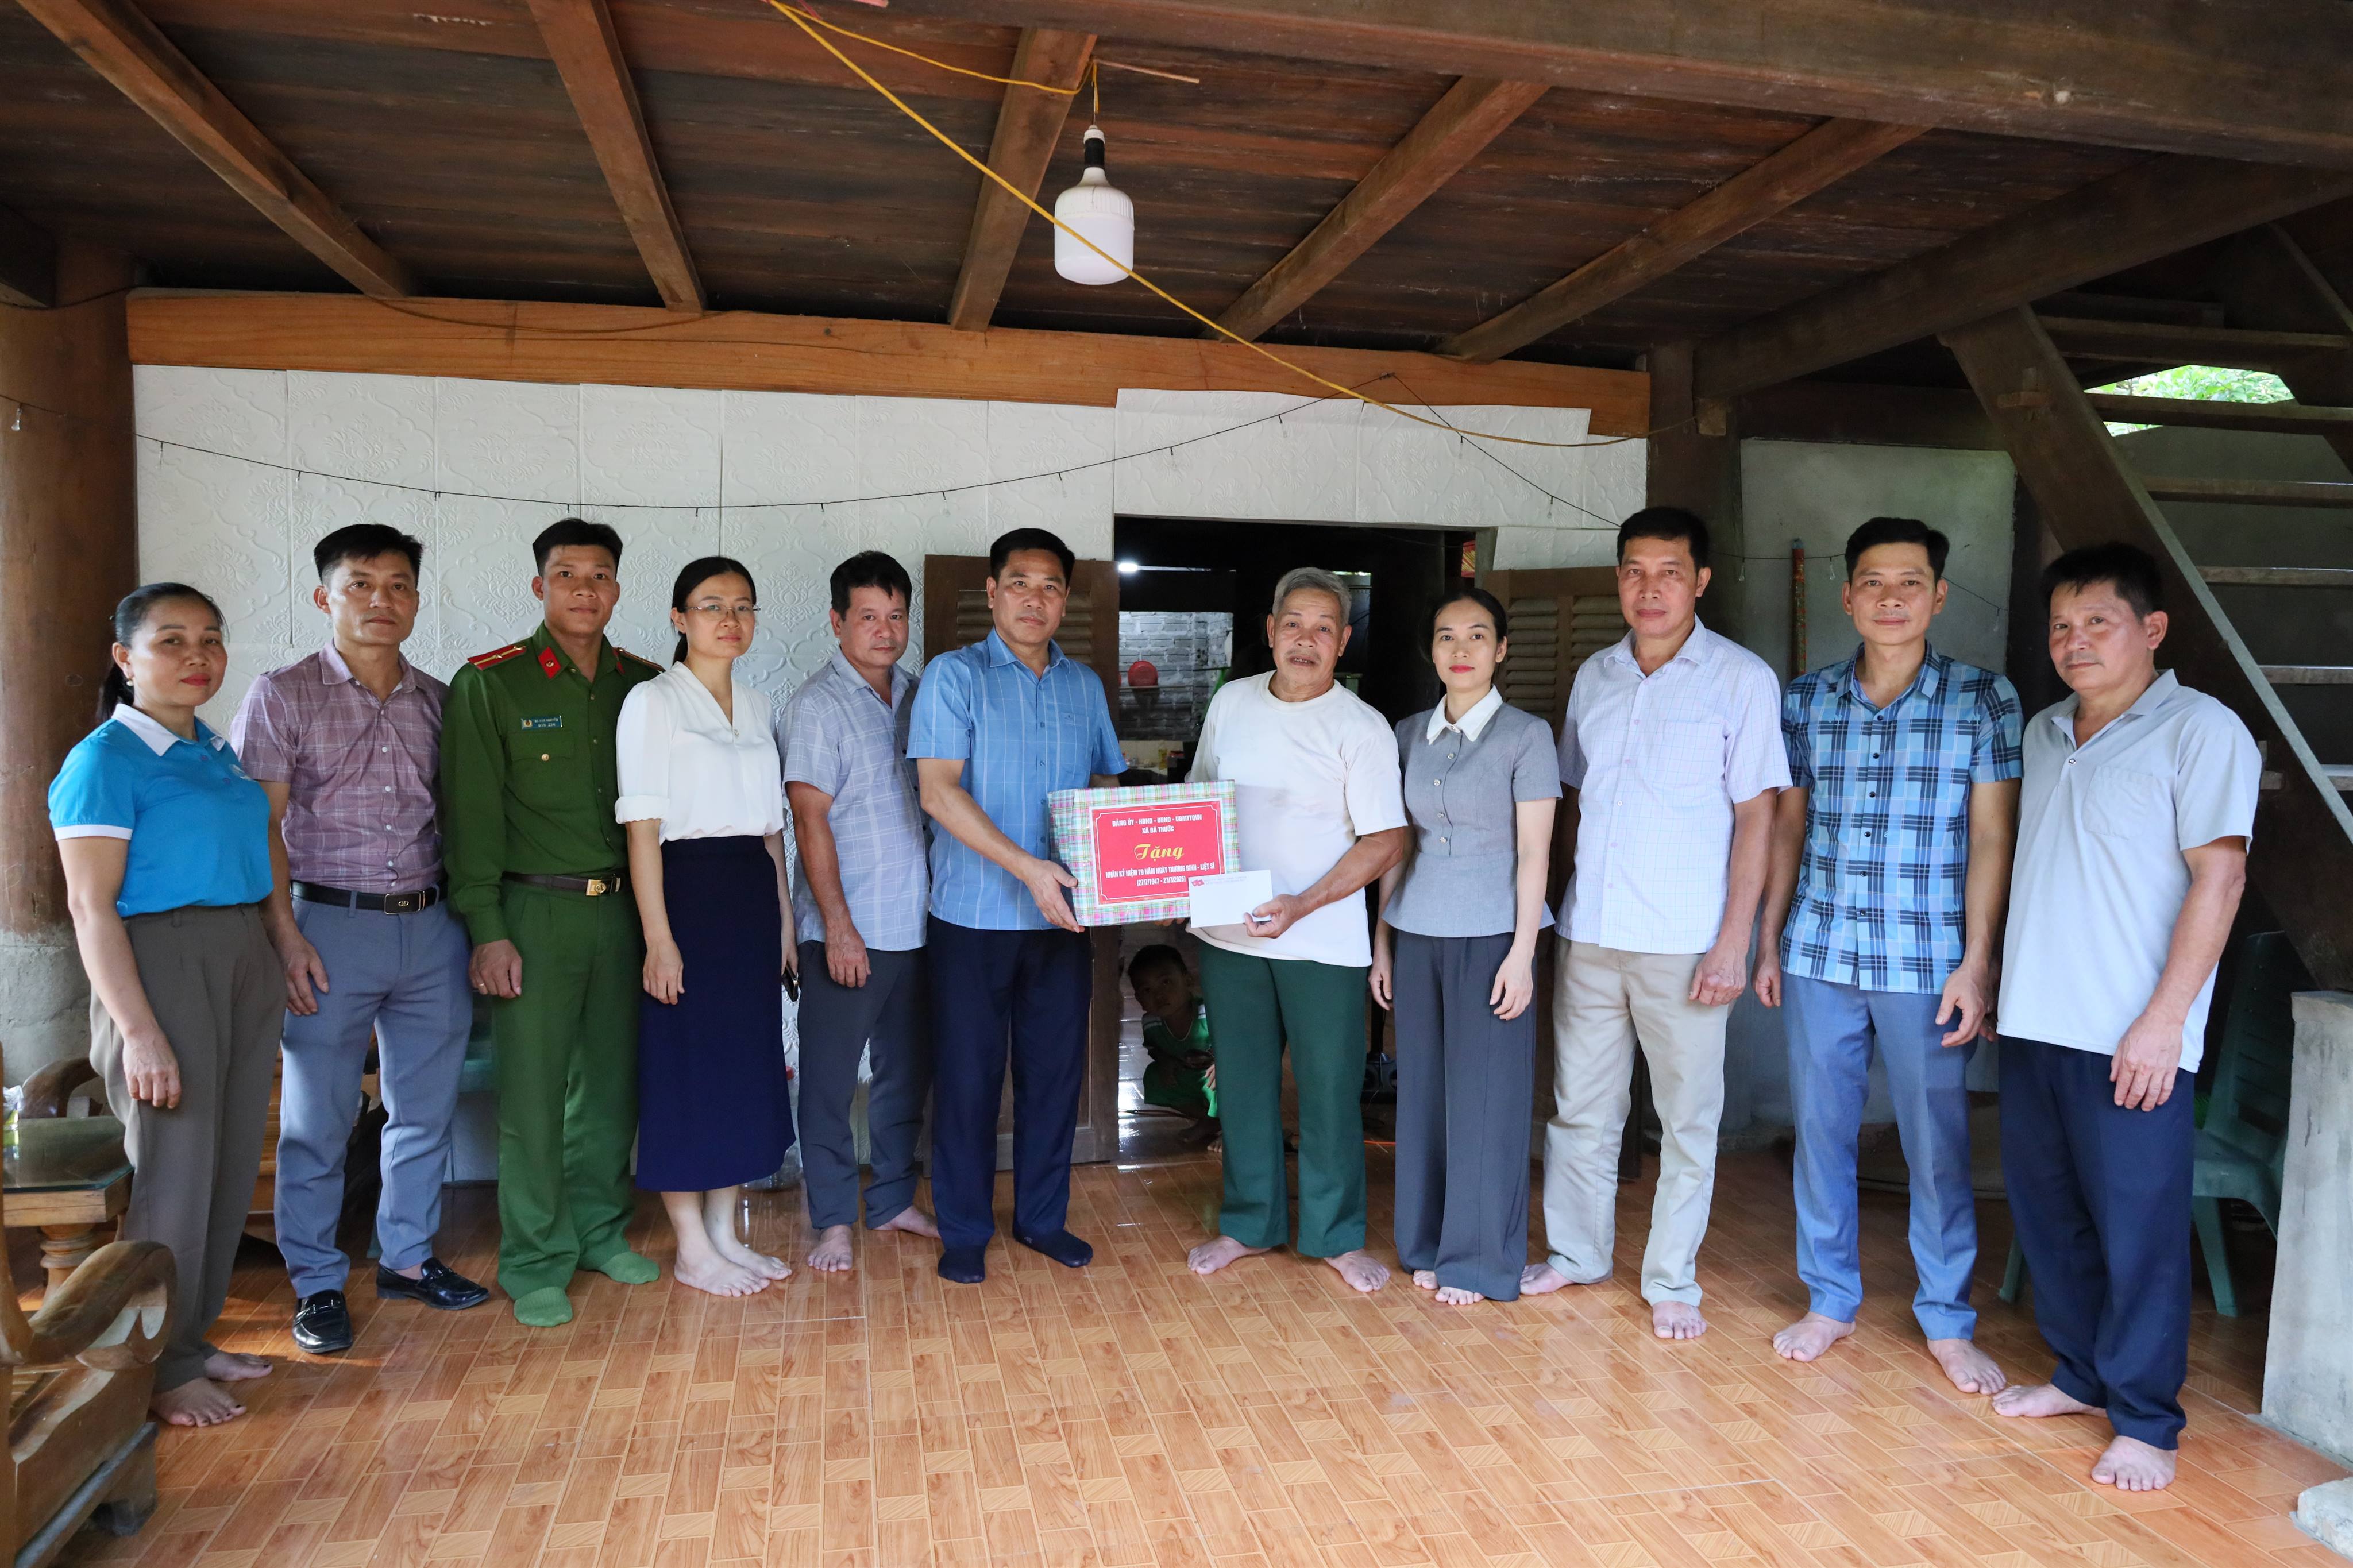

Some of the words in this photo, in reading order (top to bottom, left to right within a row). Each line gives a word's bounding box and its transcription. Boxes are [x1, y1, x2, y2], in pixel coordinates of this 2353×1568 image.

[1112, 818, 1127, 827] ĐẢNG
[1175, 814, 1202, 822] UBMTTQVN
[1134, 843, 1184, 862] Tặng
